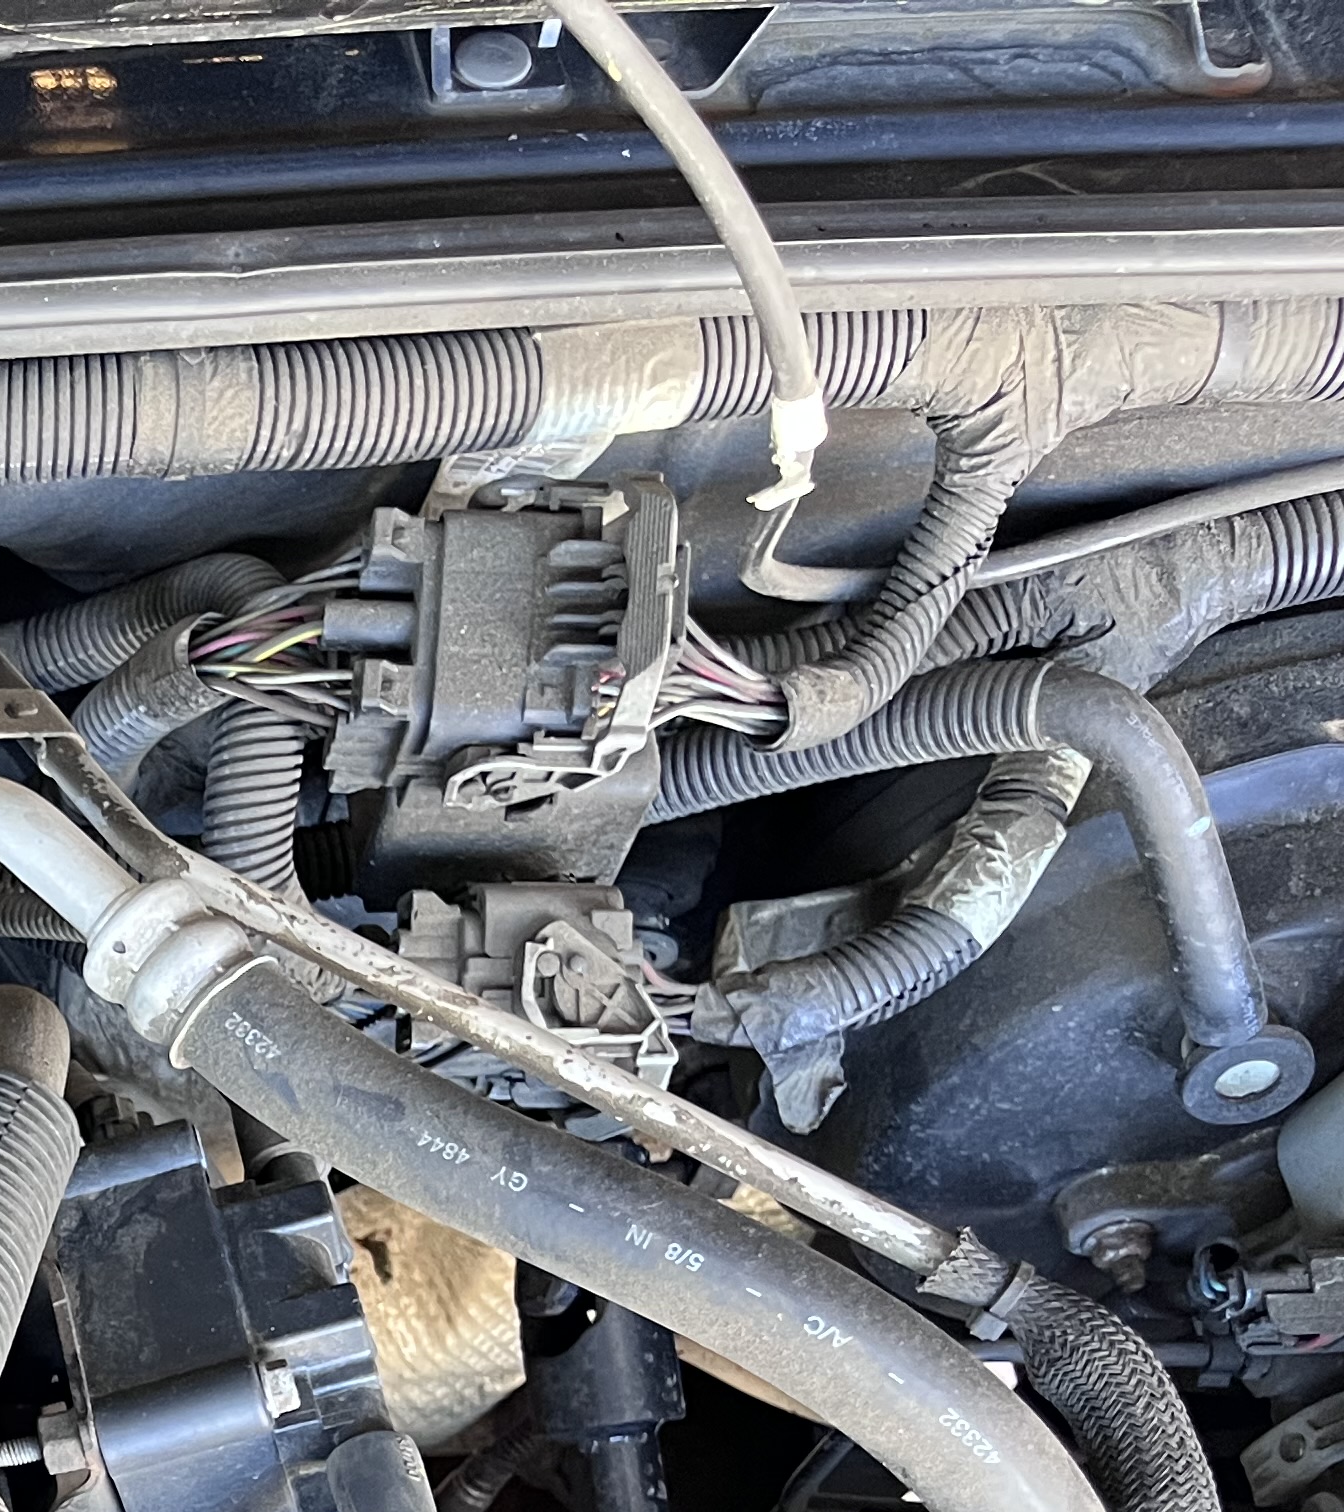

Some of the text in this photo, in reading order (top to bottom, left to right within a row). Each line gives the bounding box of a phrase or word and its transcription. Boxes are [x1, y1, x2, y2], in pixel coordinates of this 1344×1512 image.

[416, 1127, 471, 1164] 4844
[490, 1166, 529, 1191] GY
[625, 1223, 656, 1249] IN
[665, 1239, 706, 1271] 5/8
[804, 1315, 854, 1348] A/C
[939, 1408, 1001, 1463] 42332
